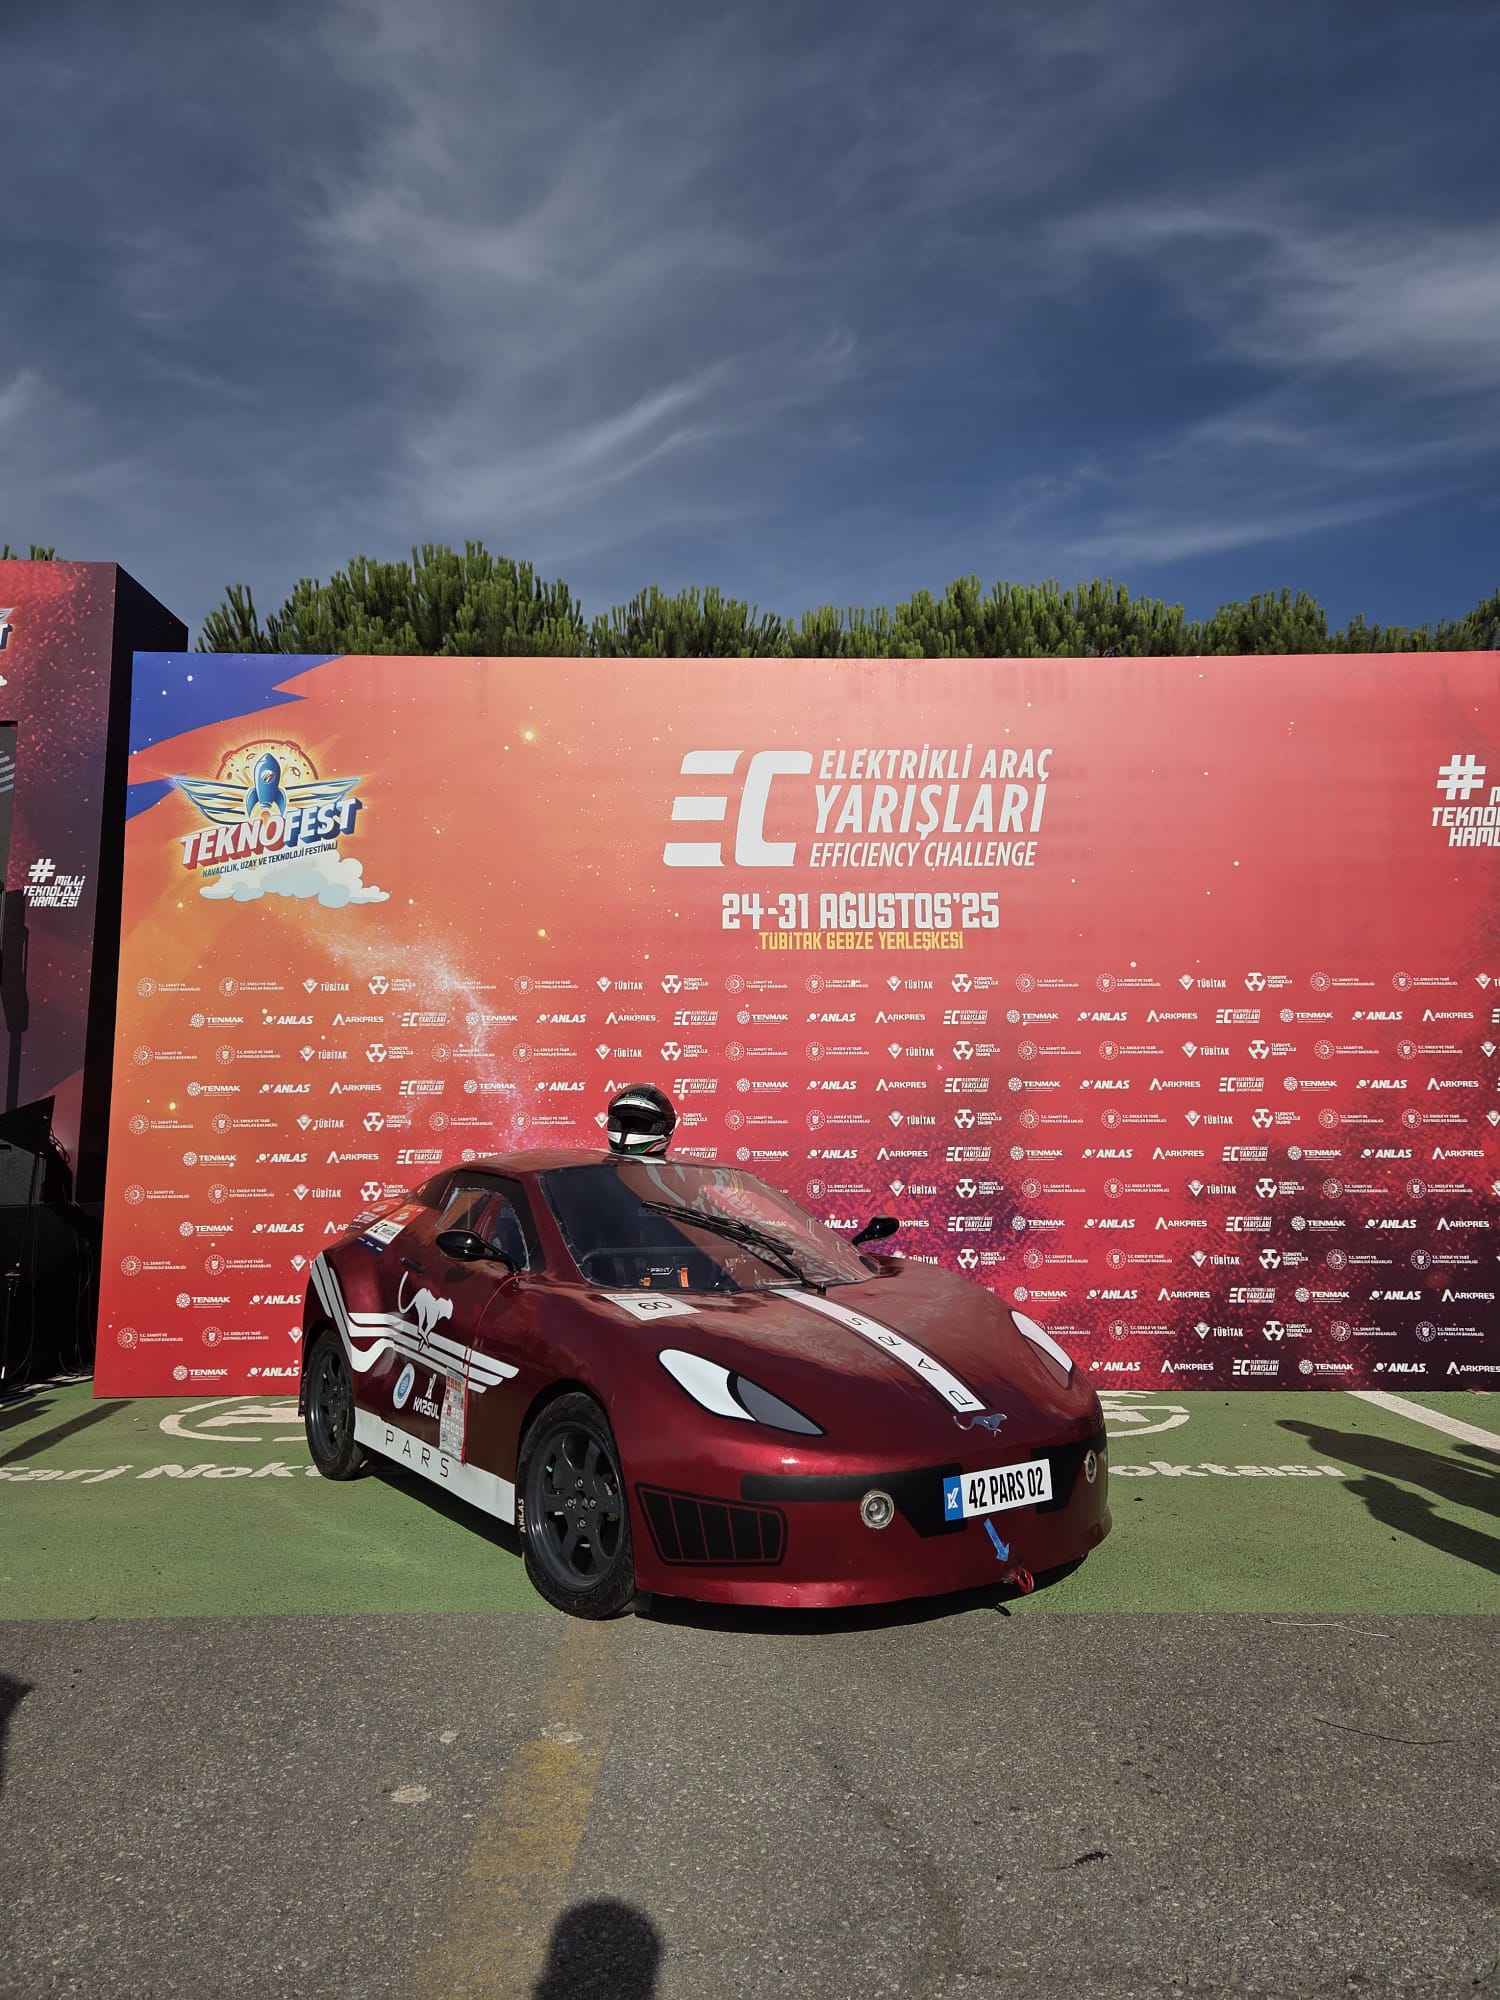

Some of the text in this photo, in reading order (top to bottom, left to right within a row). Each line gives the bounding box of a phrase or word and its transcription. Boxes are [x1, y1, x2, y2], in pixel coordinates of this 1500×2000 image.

[818, 743, 1053, 780] ELEKTRİKLİ ARAÇ
[663, 750, 814, 867] EC
[1432, 806, 1500, 826] TEKNO
[180, 799, 361, 872] TEKNOFEST
[809, 841, 1038, 868] EFFICIENCY CHALLENGE
[240, 857, 258, 870] UZAY
[258, 857, 267, 866] VE
[721, 892, 809, 930] 24-31
[759, 930, 964, 951] TÜBİTAK GEBZE YERLEŞKESİ
[321, 981, 350, 992] TÜBİTAK
[614, 980, 643, 991] TÜBİTAK
[904, 979, 933, 990] TÜBİTAK
[1198, 978, 1227, 988] TÜBİTAK
[277, 1016, 314, 1025] ANLAS
[551, 1014, 587, 1023] ANLAS
[820, 1013, 857, 1022] ANLAS
[1091, 1012, 1128, 1021] ANLAS
[1366, 1012, 1403, 1021] ANLAS
[318, 1049, 347, 1060] TÜBİTAK
[614, 1048, 642, 1058] TÜBİTAK
[906, 1046, 934, 1057] TÜBİTAK
[1200, 1045, 1230, 1056] TÜBİTAK
[274, 1084, 311, 1093] ANLAS
[550, 1082, 586, 1091] ANLAS
[821, 1080, 857, 1090] ANLAS
[1094, 1080, 1130, 1089] ANLAS
[1371, 1080, 1408, 1089] ANLAS
[316, 1118, 344, 1128] TÜBİTAK
[907, 1114, 936, 1125] TÜBİTAK
[1204, 1114, 1233, 1124] TÜBİTAK
[200, 1154, 237, 1162] TENMAK
[270, 1153, 308, 1162] ANLAS
[822, 1150, 858, 1159] ANLAS
[1096, 1149, 1133, 1159] ANLAS
[1375, 1149, 1412, 1159] ANLAS
[312, 1188, 341, 1198] TÜBİTAK
[908, 1184, 937, 1195] TÜBİTAK
[1207, 1183, 1237, 1194] TÜBİTAK
[267, 1224, 305, 1233] ANLAS
[1099, 1219, 1136, 1228] ANLAS
[1380, 1219, 1417, 1229] ANLAS
[1450, 1220, 1489, 1228] ARKPRES
[1210, 1254, 1240, 1265] TÜBİTAK
[264, 1295, 302, 1304] ANLAS
[1101, 1290, 1138, 1299] ANLAS
[1384, 1290, 1422, 1300] ANLAS
[638, 1301, 673, 1311] 60
[1213, 1326, 1243, 1337] TÜBİTAK
[1104, 1362, 1141, 1371] ANLAS
[1388, 1363, 1426, 1372] ANLAS
[262, 1367, 300, 1377] ANLAS
[384, 1429, 449, 1478] PARS
[968, 1466, 1045, 1509] 42 PARS 02
